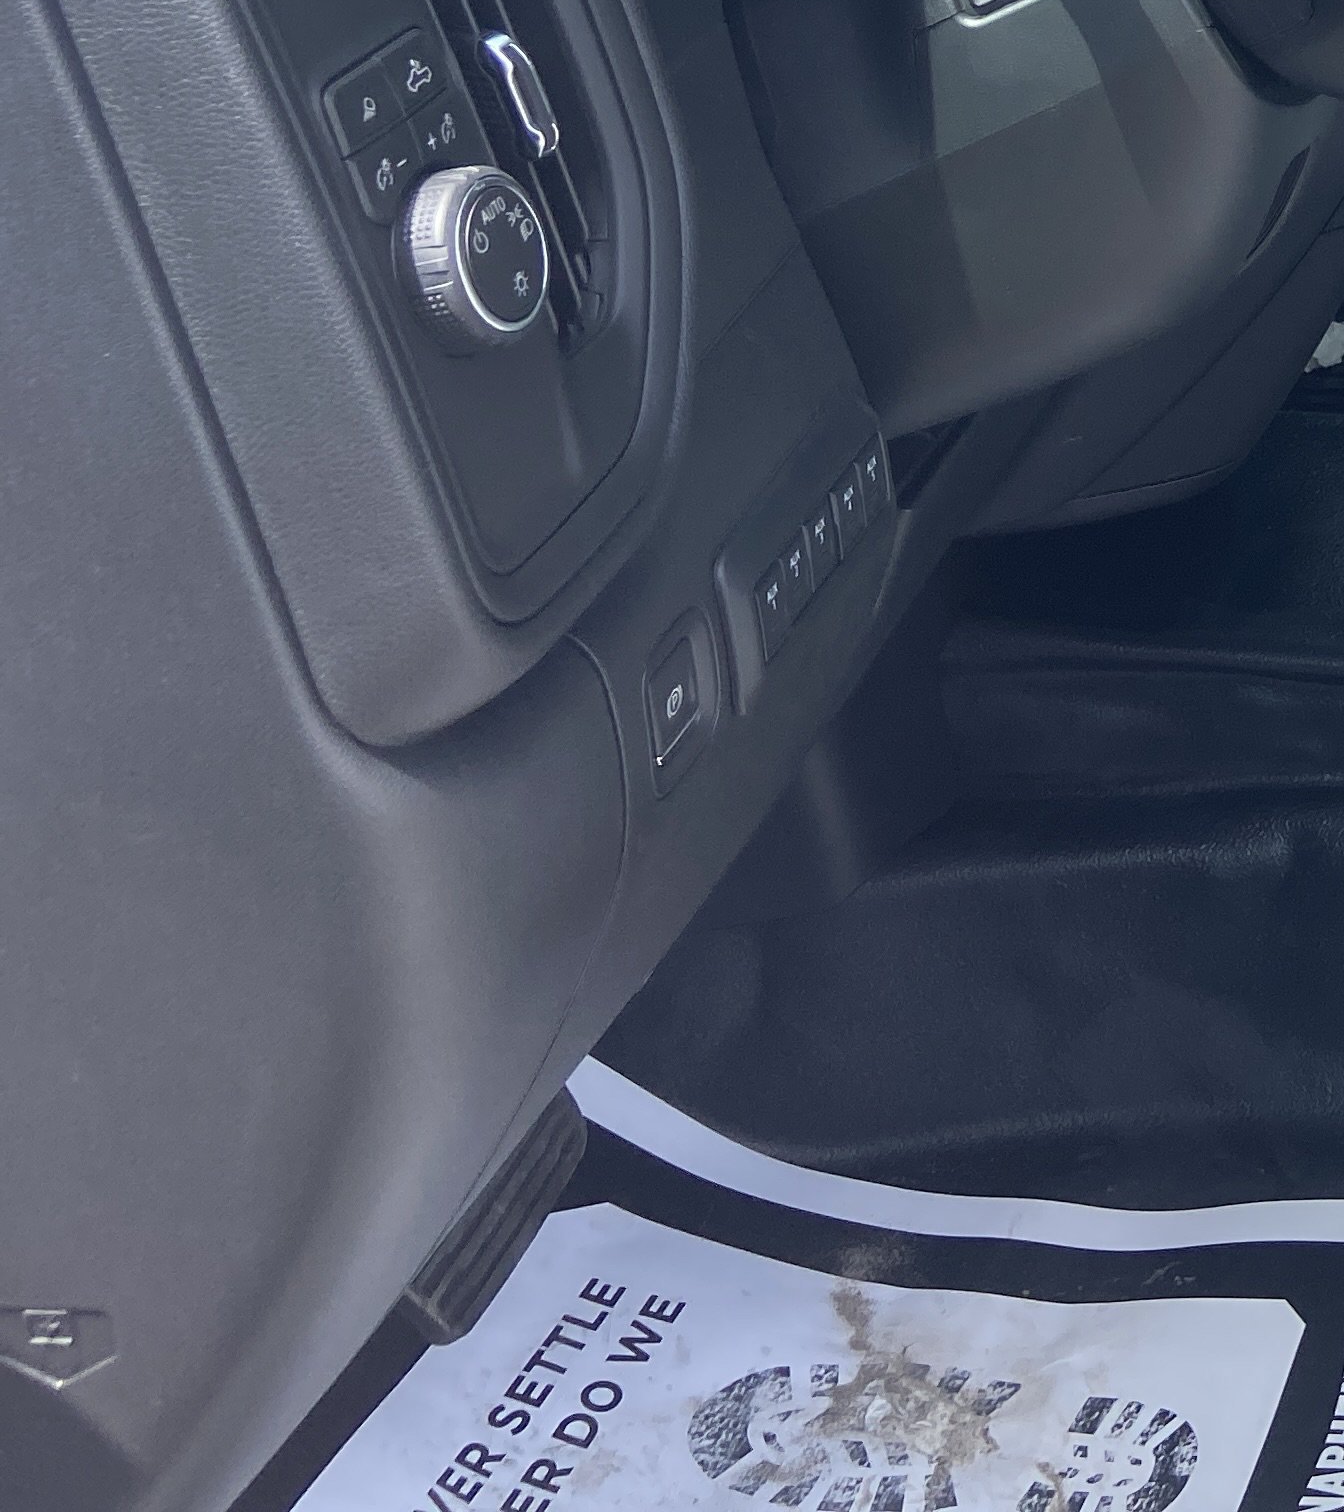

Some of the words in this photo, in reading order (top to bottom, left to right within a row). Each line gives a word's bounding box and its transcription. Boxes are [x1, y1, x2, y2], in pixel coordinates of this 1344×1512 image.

[481, 197, 506, 224] AUTO
[487, 1277, 627, 1436] SETTLE
[552, 1380, 623, 1449] DO
[606, 1294, 687, 1363] WE
